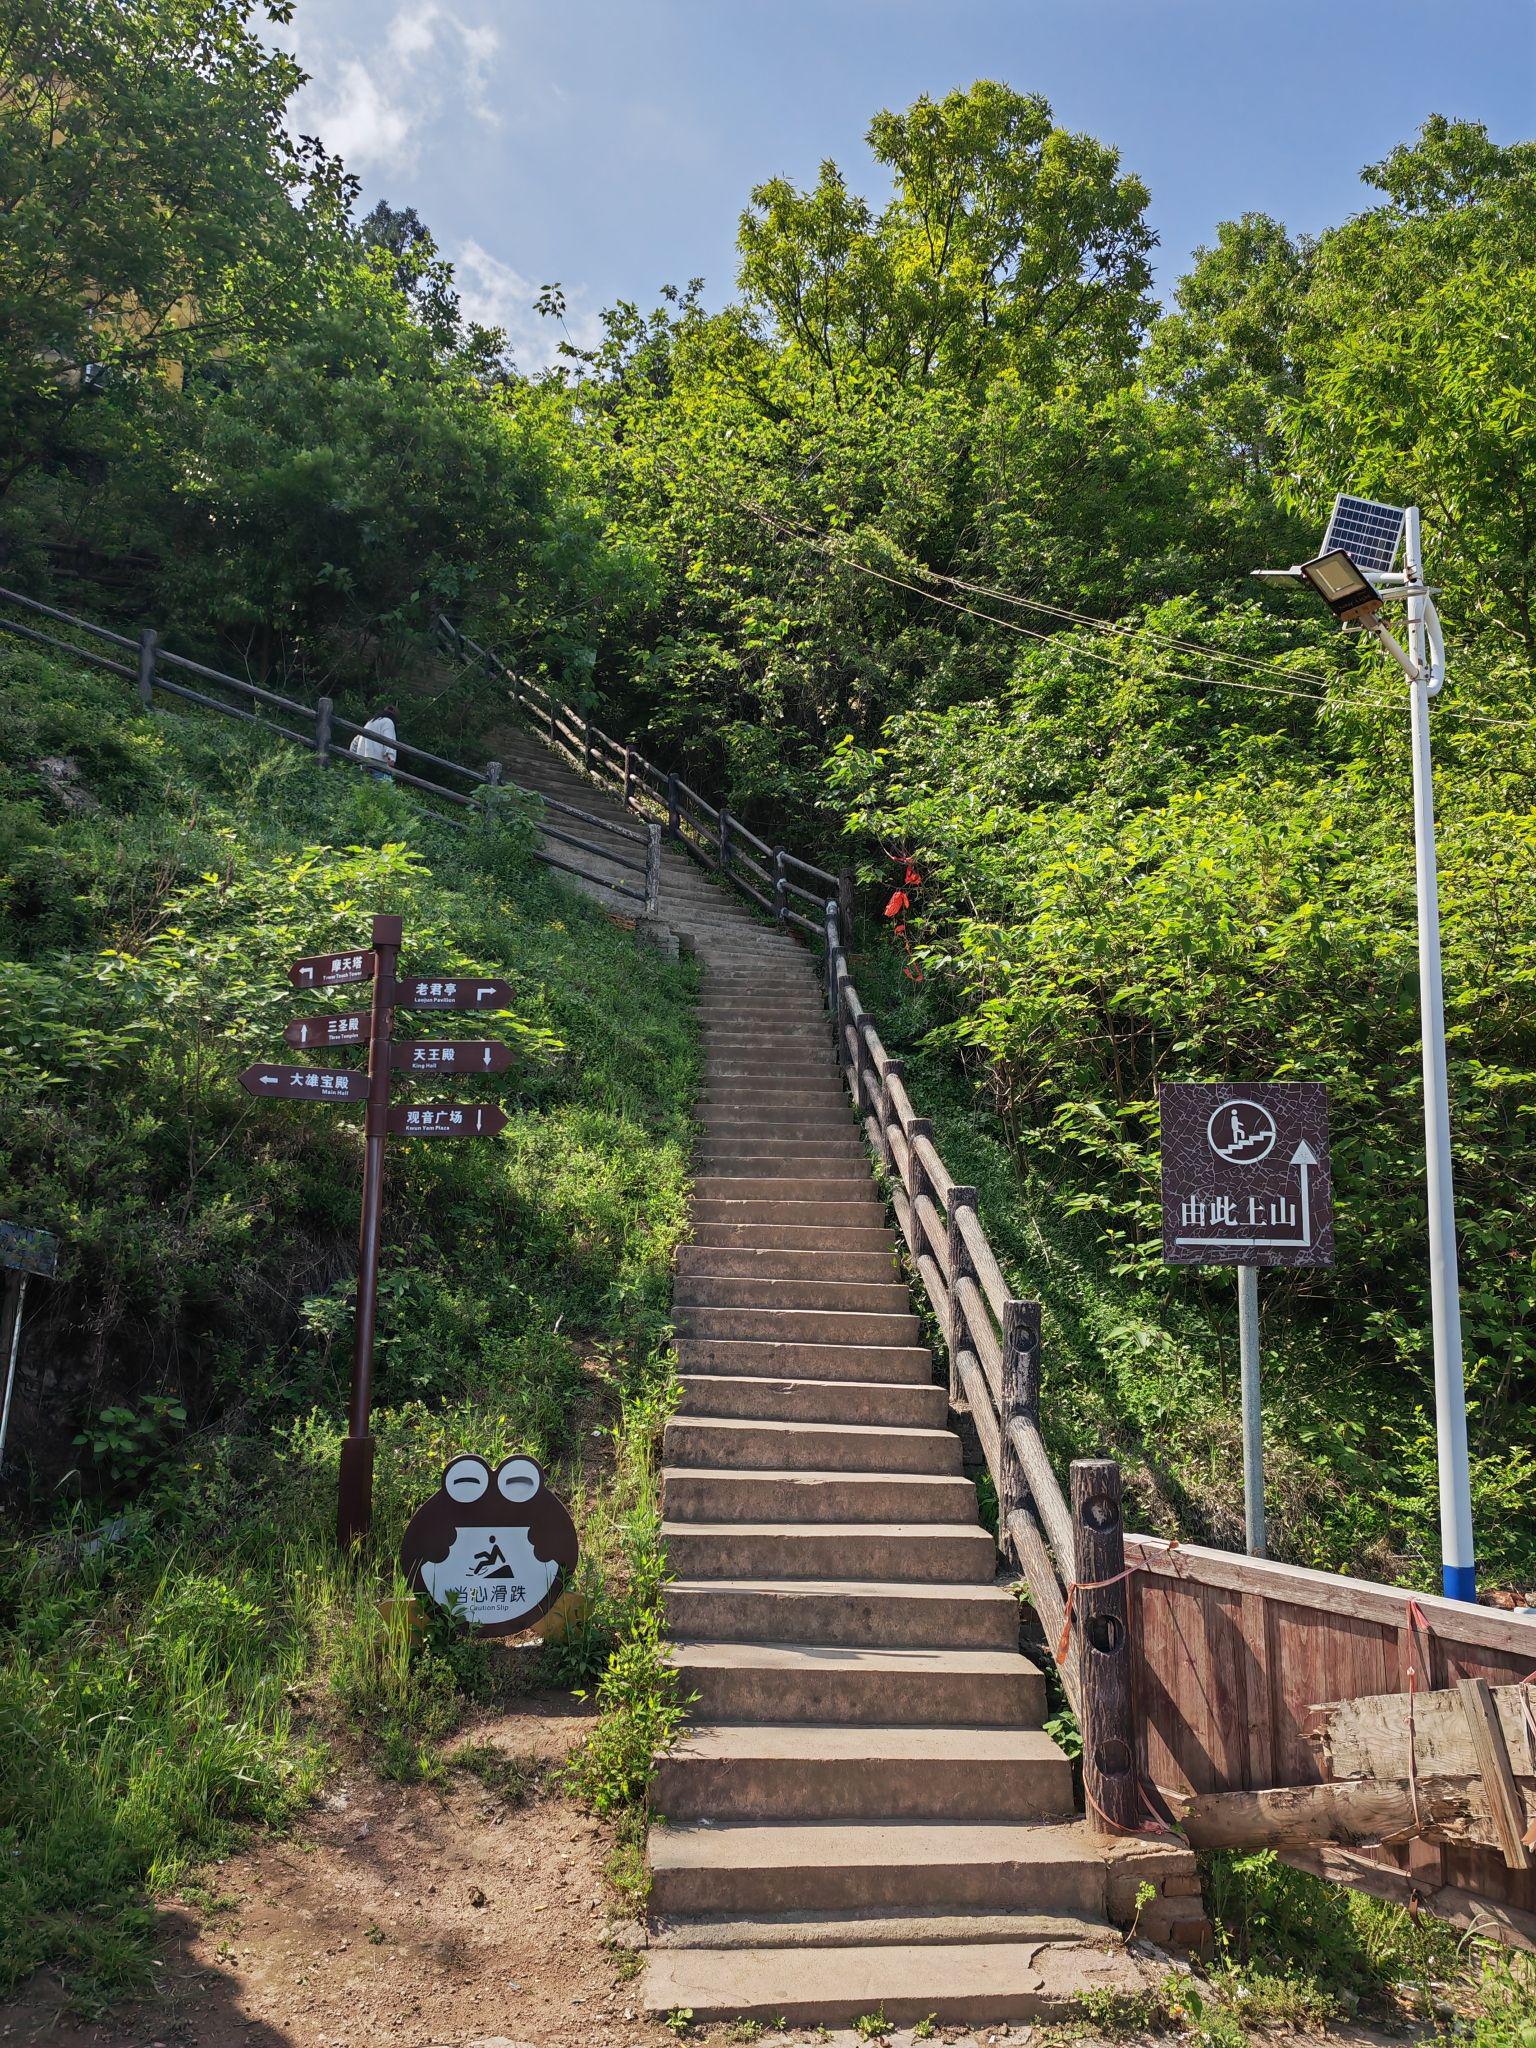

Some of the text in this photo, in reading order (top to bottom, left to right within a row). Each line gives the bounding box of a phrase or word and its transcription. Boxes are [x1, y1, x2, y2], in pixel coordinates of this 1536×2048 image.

[331, 956, 362, 972] 摩天塔
[416, 982, 456, 996] 老君亭
[328, 1018, 359, 1032] 三圣殿
[413, 1048, 455, 1061] 天王殿
[290, 1072, 349, 1089] 大雄宝殿
[406, 1110, 463, 1124] 观音广场
[1181, 1195, 1296, 1227] 由此上山
[454, 1585, 526, 1603] 当心滑跌
